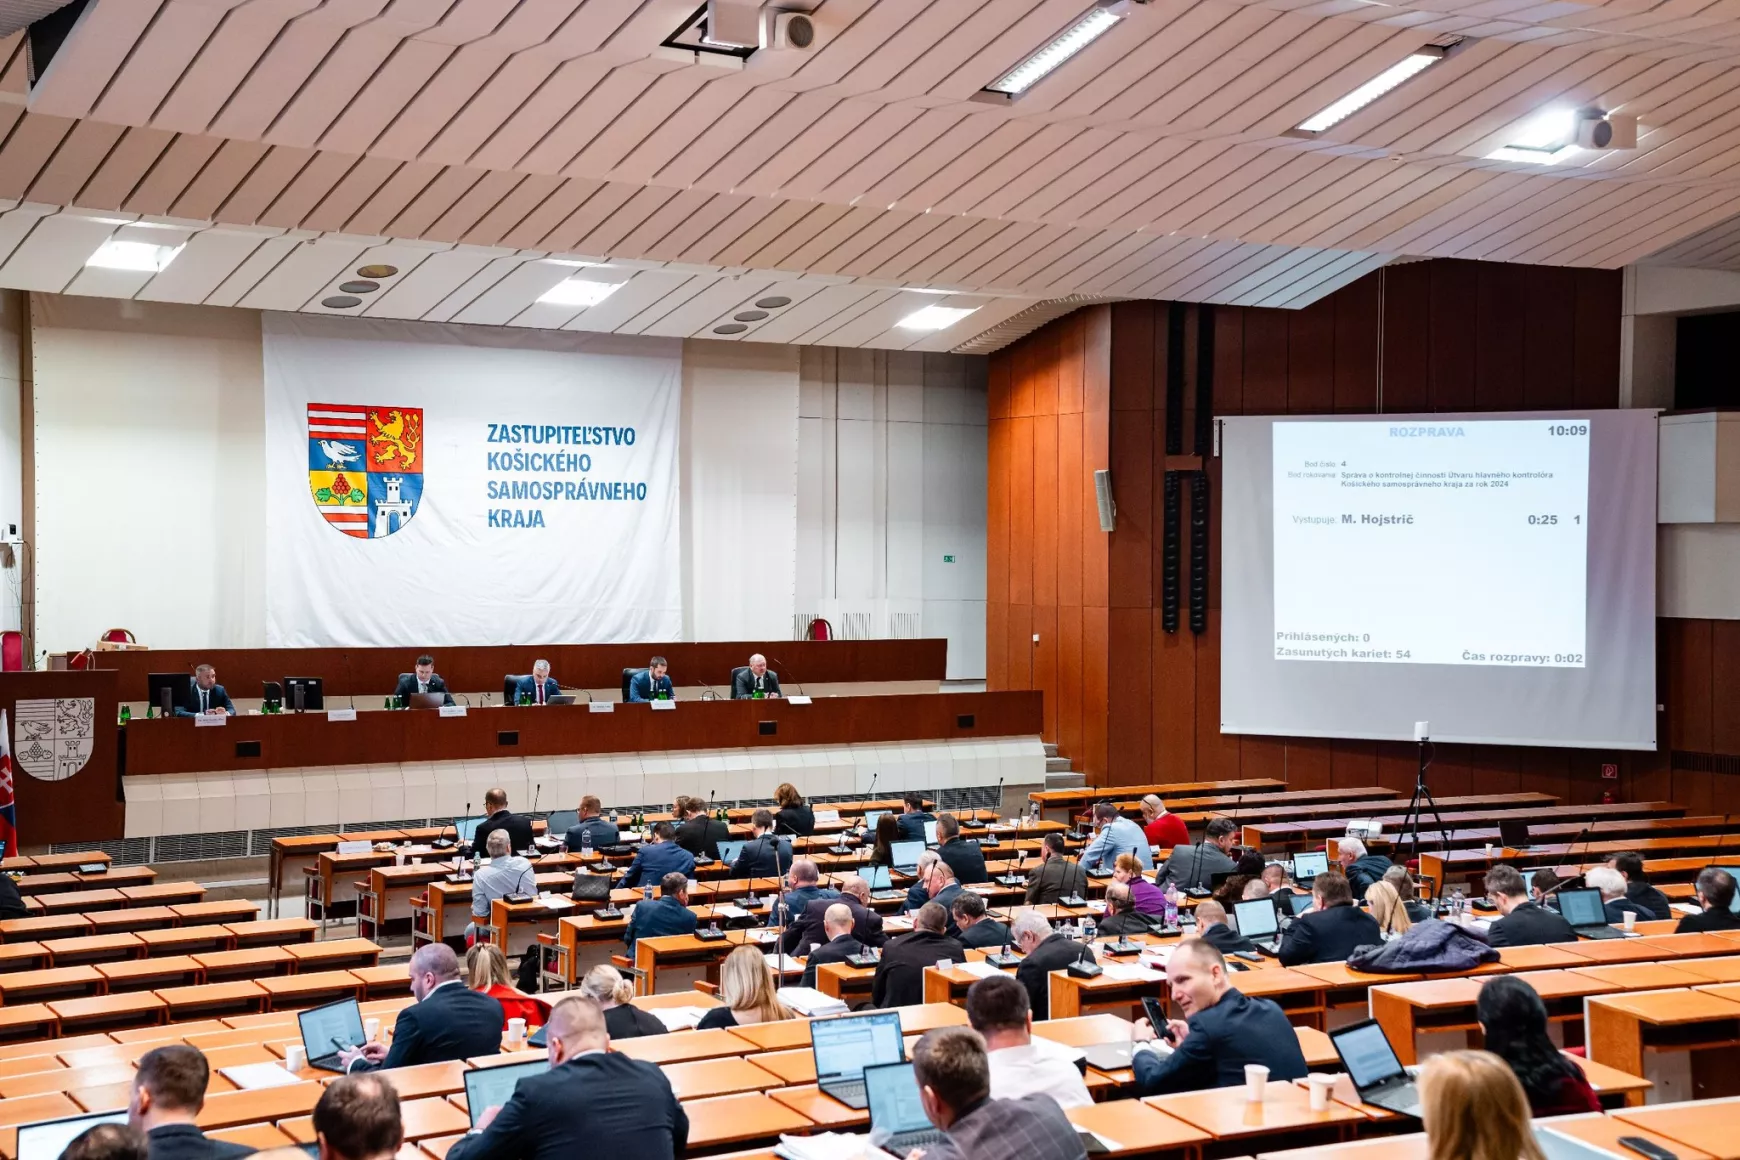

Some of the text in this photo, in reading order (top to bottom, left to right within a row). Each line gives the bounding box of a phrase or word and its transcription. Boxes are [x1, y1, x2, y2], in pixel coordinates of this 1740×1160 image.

[487, 424, 636, 446] ZASTUPITEĽSTVO
[1389, 426, 1466, 437] ROZPRAVA
[1548, 425, 1587, 436] 10:09
[487, 448, 592, 472] KOŠICKÉHO
[1304, 460, 1318, 468] Bod
[1341, 471, 1367, 479] Správa
[487, 477, 647, 501] SAMOSPRÁVNEHO
[1382, 480, 1442, 488] samosprávneho
[1443, 481, 1463, 489] kraja
[488, 508, 546, 528] KRAJA
[1341, 514, 1357, 524] M.
[1361, 514, 1414, 527] Hojstrič
[1528, 514, 1581, 525] 0:25 1
[1276, 631, 1371, 644] Prihlásených: 0
[1276, 647, 1412, 659] Zasunutých kariet: 54
[1461, 649, 1583, 665] Čas rozpravy: 0:02
